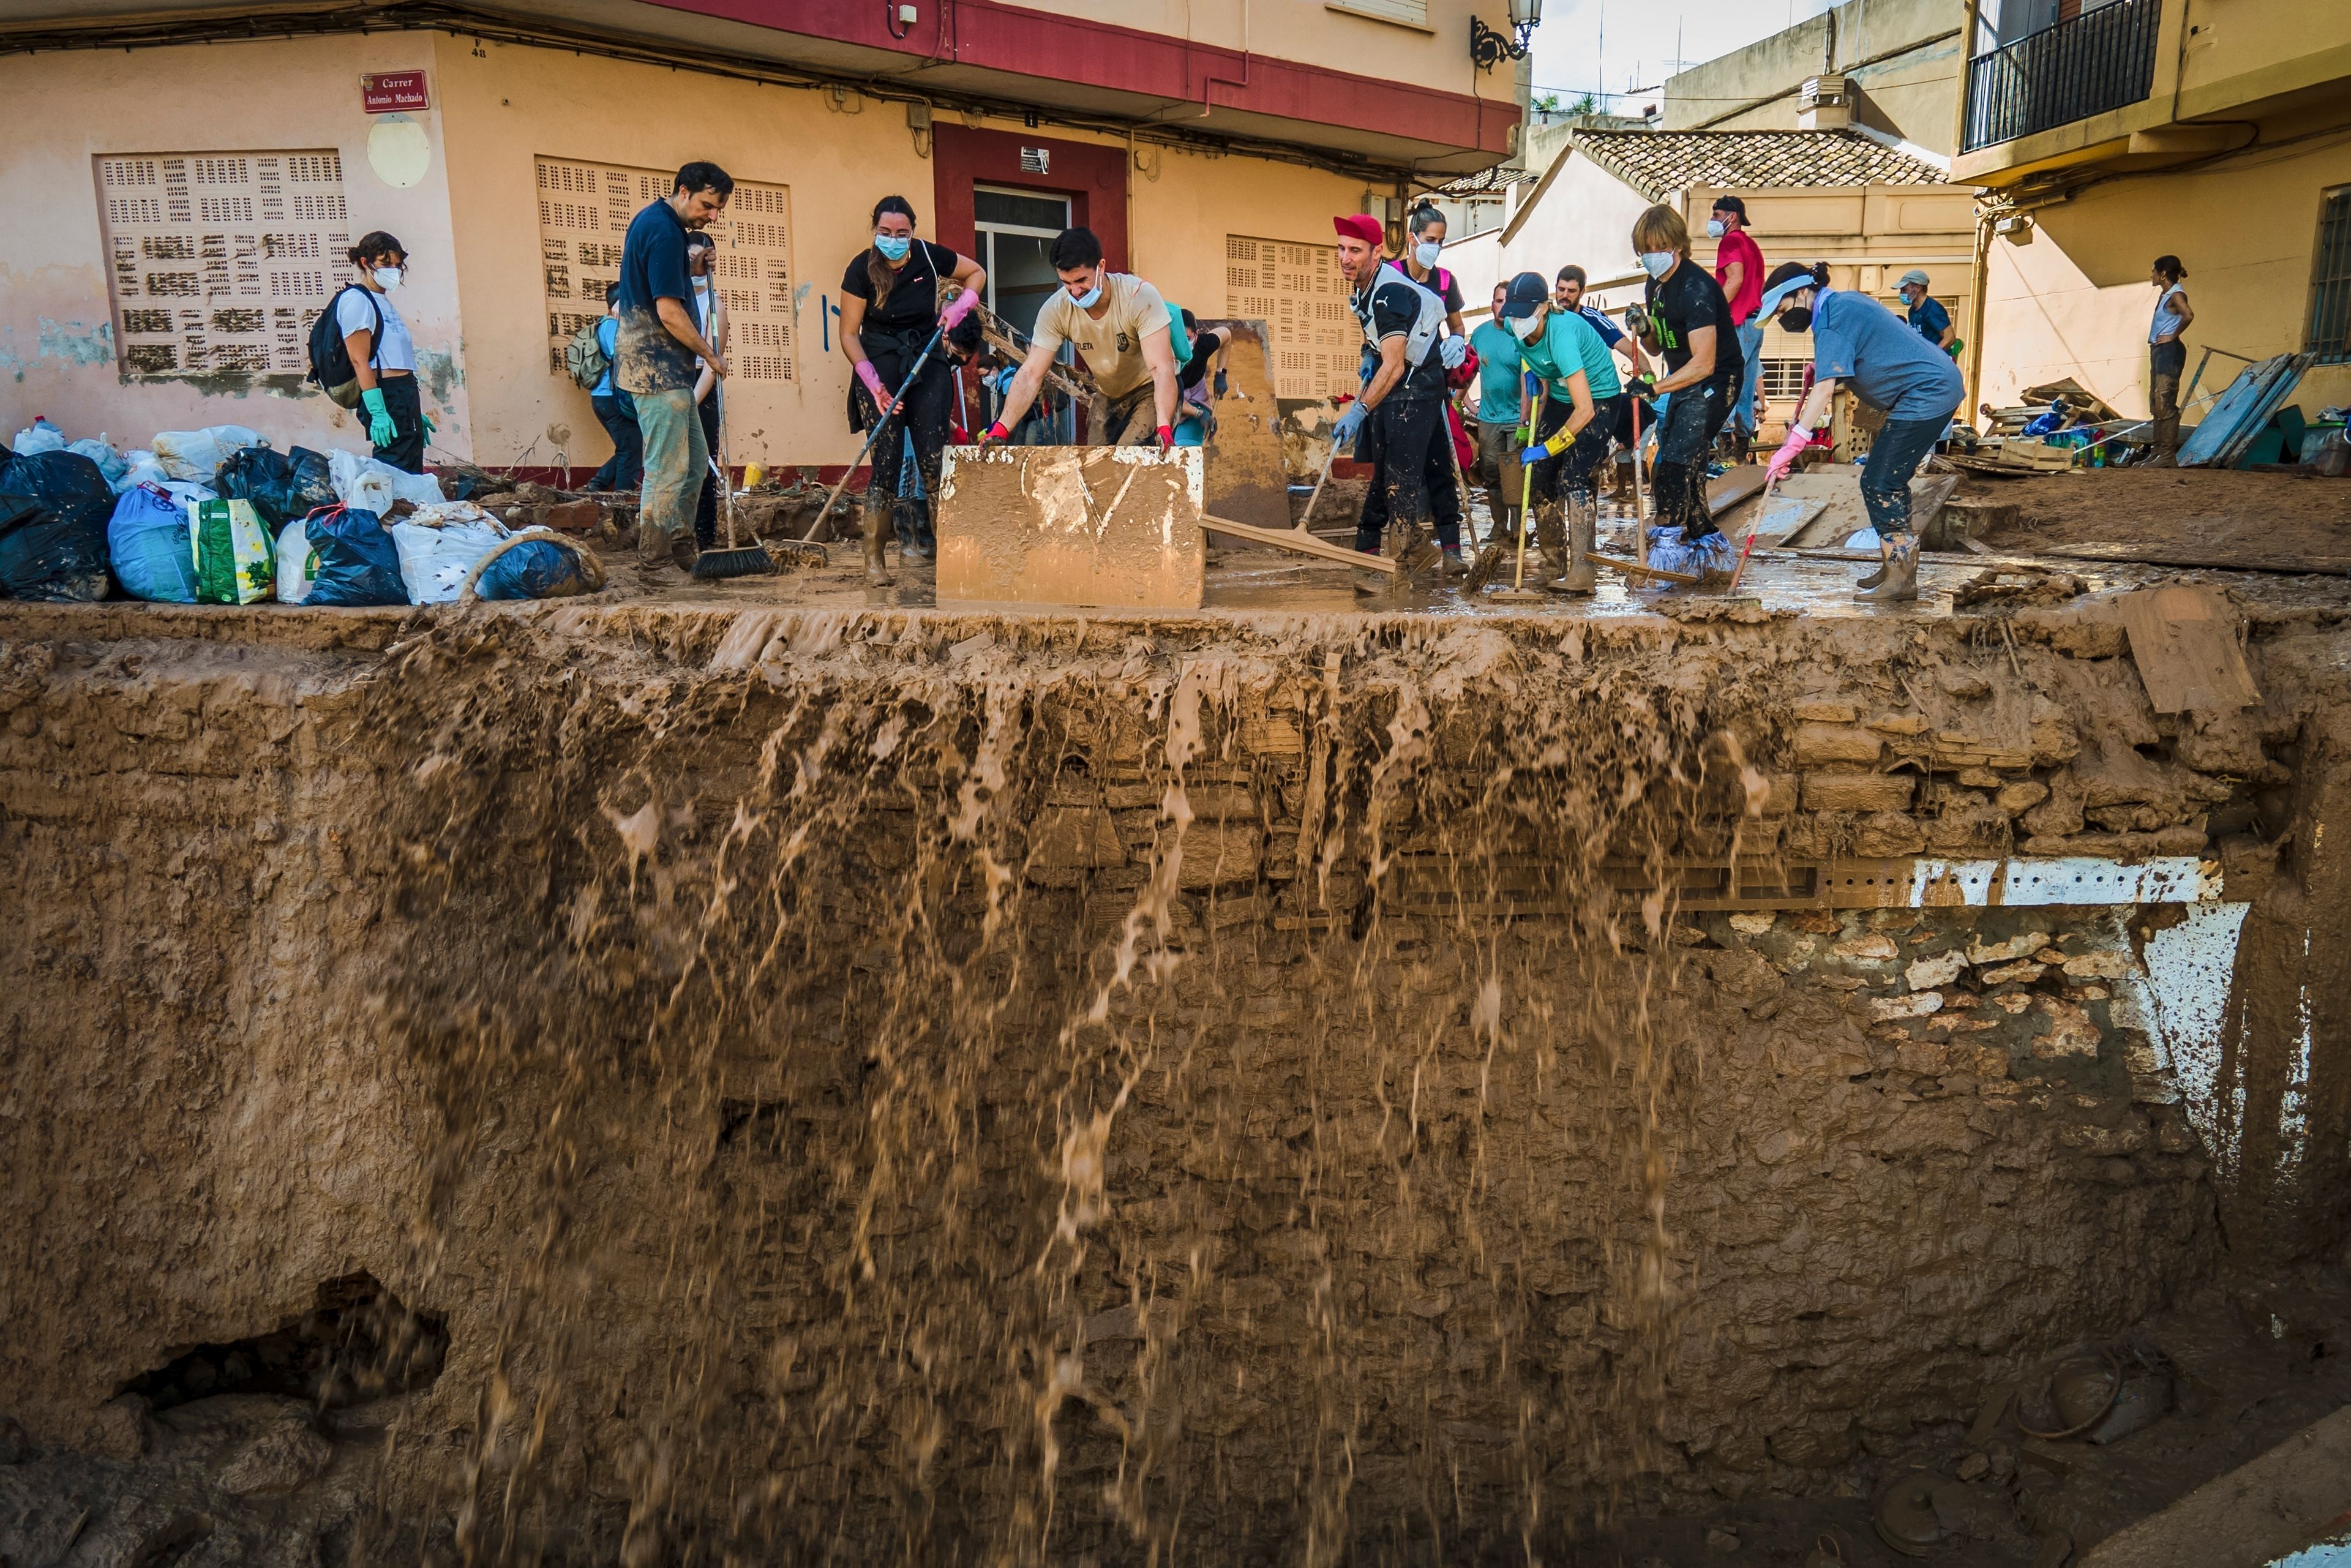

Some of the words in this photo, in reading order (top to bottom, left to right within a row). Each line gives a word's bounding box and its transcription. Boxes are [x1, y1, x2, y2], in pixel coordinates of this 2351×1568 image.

[471, 48, 486, 58] 48
[382, 78, 413, 88] Carrer
[367, 95, 392, 105] Antonio
[395, 92, 422, 103] Machado
